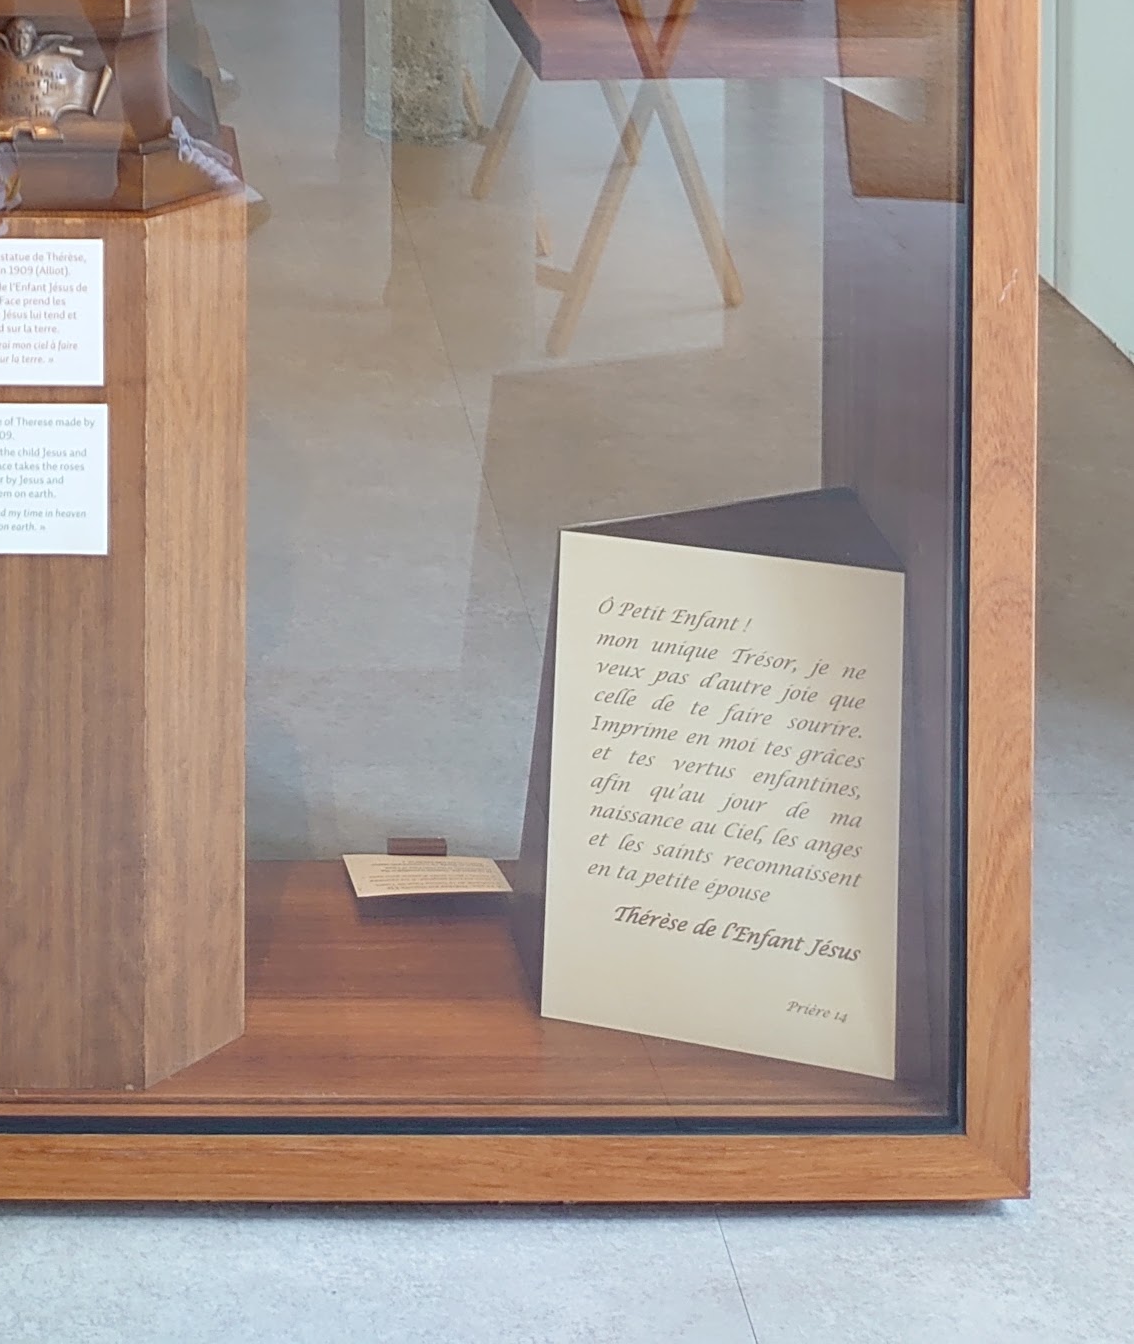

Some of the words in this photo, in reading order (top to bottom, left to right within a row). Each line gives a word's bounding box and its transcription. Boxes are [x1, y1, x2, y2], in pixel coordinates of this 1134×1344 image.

[1, 253, 30, 261] statue
[33, 252, 44, 261] de
[47, 252, 86, 263] Thérèse,
[10, 266, 33, 274] 1909
[0, 296, 20, 305] Face
[23, 297, 50, 307] prend
[53, 296, 66, 305] les
[10, 282, 46, 292] l'Enfant
[49, 283, 73, 293] Jésus
[76, 283, 87, 292] de
[3, 310, 27, 321] Jésus
[30, 310, 41, 319] lui
[44, 310, 65, 320] tend
[68, 312, 76, 320] et
[5, 417, 13, 426] of
[17, 417, 53, 426] Therese
[56, 418, 81, 426] made
[84, 418, 95, 428] by
[0, 447, 15, 456] the
[18, 448, 40, 456] child
[42, 448, 67, 458] Jesus
[70, 448, 86, 457] and
[15, 461, 39, 470] takes
[43, 461, 57, 471] the
[6, 475, 16, 486] by
[19, 475, 44, 486] Jesus
[47, 476, 64, 484] and
[599, 597, 614, 614] Ô
[618, 603, 666, 621] Petit
[671, 610, 739, 631] Enfant
[597, 634, 638, 649] mon
[652, 641, 718, 662] unique
[732, 648, 796, 673] Trésor,
[804, 659, 829, 679] je
[842, 664, 867, 681] ne
[598, 662, 645, 678] veux
[648, 671, 689, 686] pas
[700, 672, 771, 696] d'autre
[775, 685, 818, 704] joie
[829, 695, 865, 711] que
[594, 688, 636, 706] celle
[652, 694, 674, 711] de
[690, 702, 709, 716] te
[717, 704, 772, 725] faire
[787, 718, 861, 738] sourire.
[591, 716, 678, 740] Imprime
[686, 733, 709, 745] en
[718, 737, 755, 752] moi
[764, 741, 792, 757] tes
[796, 749, 865, 768] grâces
[592, 747, 612, 760] et
[628, 751, 655, 766] tes
[675, 760, 736, 778] vertus
[753, 770, 860, 800] enfantines,
[591, 773, 630, 794] afin
[650, 784, 705, 803] qu'au
[717, 793, 767, 812] jour
[786, 802, 809, 819] de
[830, 813, 862, 828] ma
[590, 805, 684, 829] naissance
[690, 822, 716, 834] au
[724, 823, 768, 844] Ciel,
[772, 828, 798, 847] les
[805, 839, 862, 860] anges
[589, 833, 608, 846] et
[618, 834, 644, 852] les
[653, 845, 713, 863] saints
[724, 849, 862, 887] reconnaissent
[588, 861, 612, 877] en
[617, 866, 637, 881] ta
[639, 870, 700, 892] petite
[705, 879, 770, 902] épouse
[615, 906, 688, 931] Thérèse
[693, 919, 716, 936] de
[722, 923, 805, 951] l'Enfant
[804, 939, 861, 961] Jésus
[787, 1001, 830, 1018] Prière
[833, 1010, 848, 1024] 14
